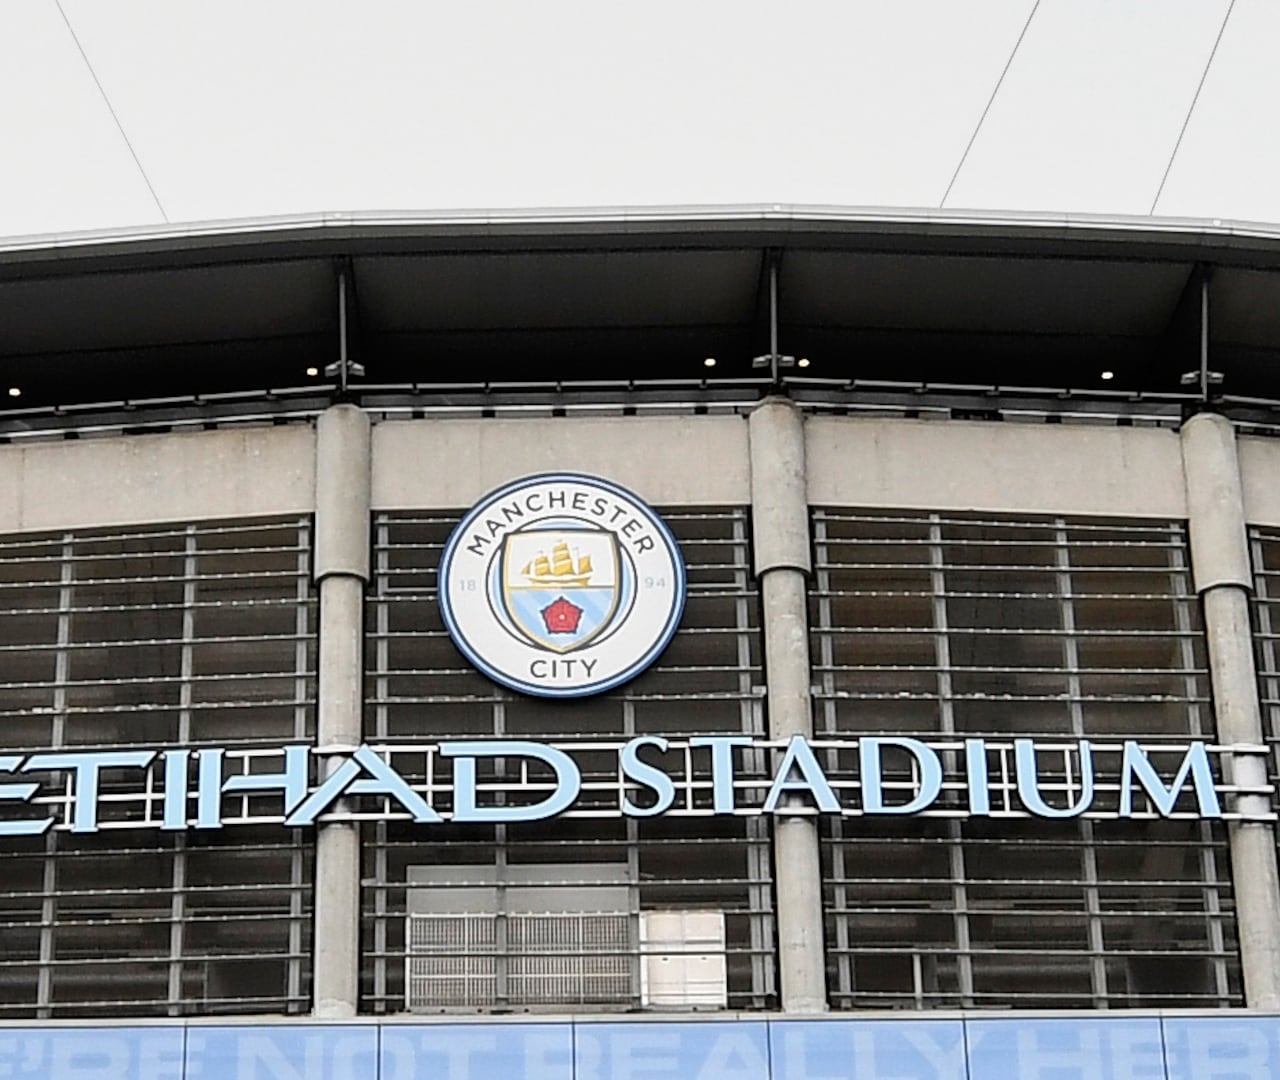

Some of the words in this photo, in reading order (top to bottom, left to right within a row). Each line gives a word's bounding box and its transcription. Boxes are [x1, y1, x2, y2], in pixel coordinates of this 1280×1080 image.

[467, 491, 656, 556] MANCHESTER
[459, 579, 477, 592] 18
[644, 577, 666, 590] 94
[530, 659, 598, 679] CITY
[619, 734, 1222, 819] STADIUM
